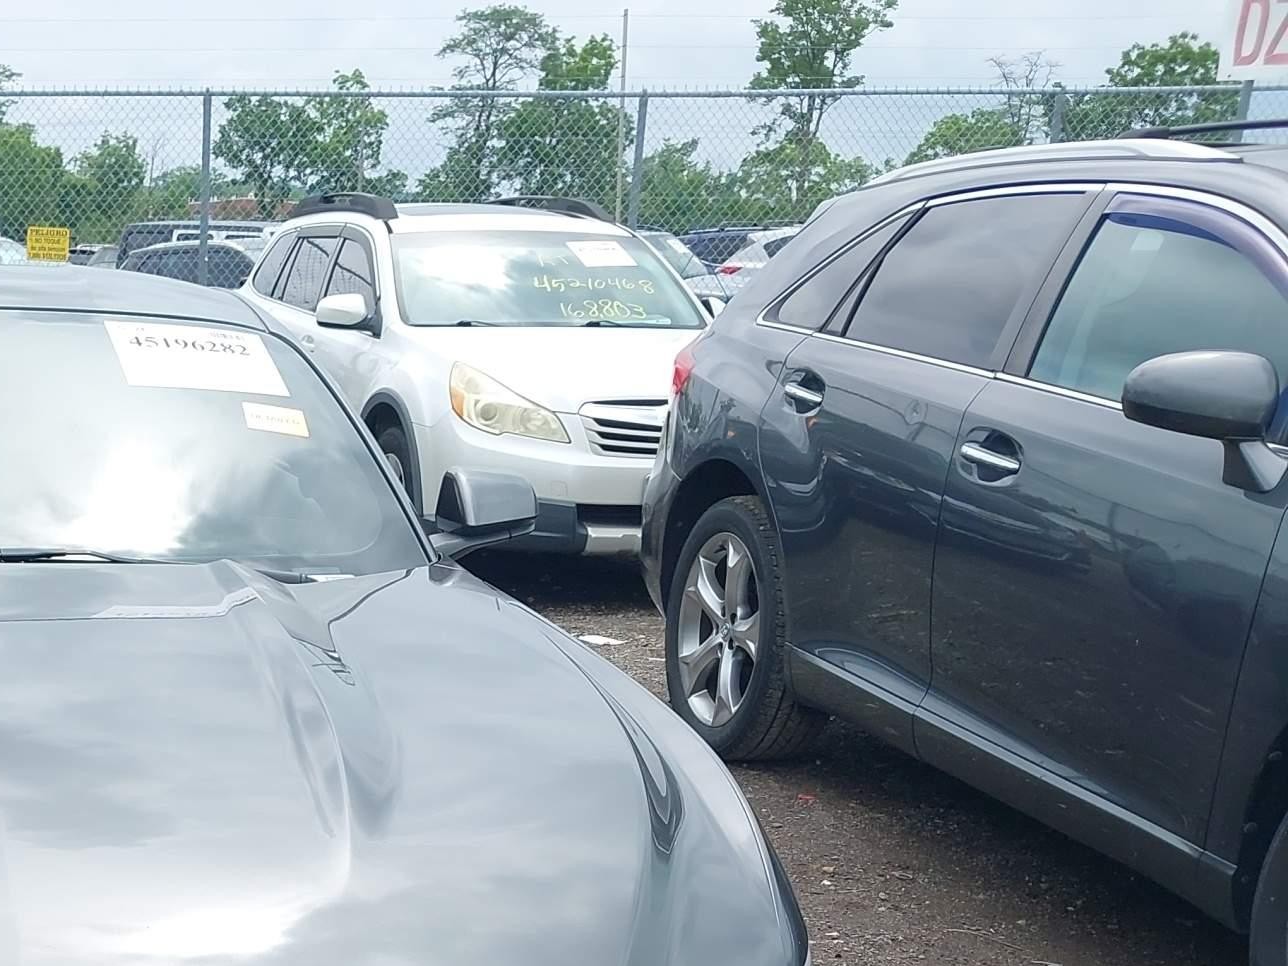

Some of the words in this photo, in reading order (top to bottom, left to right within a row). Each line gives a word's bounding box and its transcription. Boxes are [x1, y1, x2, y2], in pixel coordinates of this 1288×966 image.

[29, 228, 68, 237] PELIGRO
[533, 275, 656, 295] 45210468
[129, 335, 251, 356] 45196282
